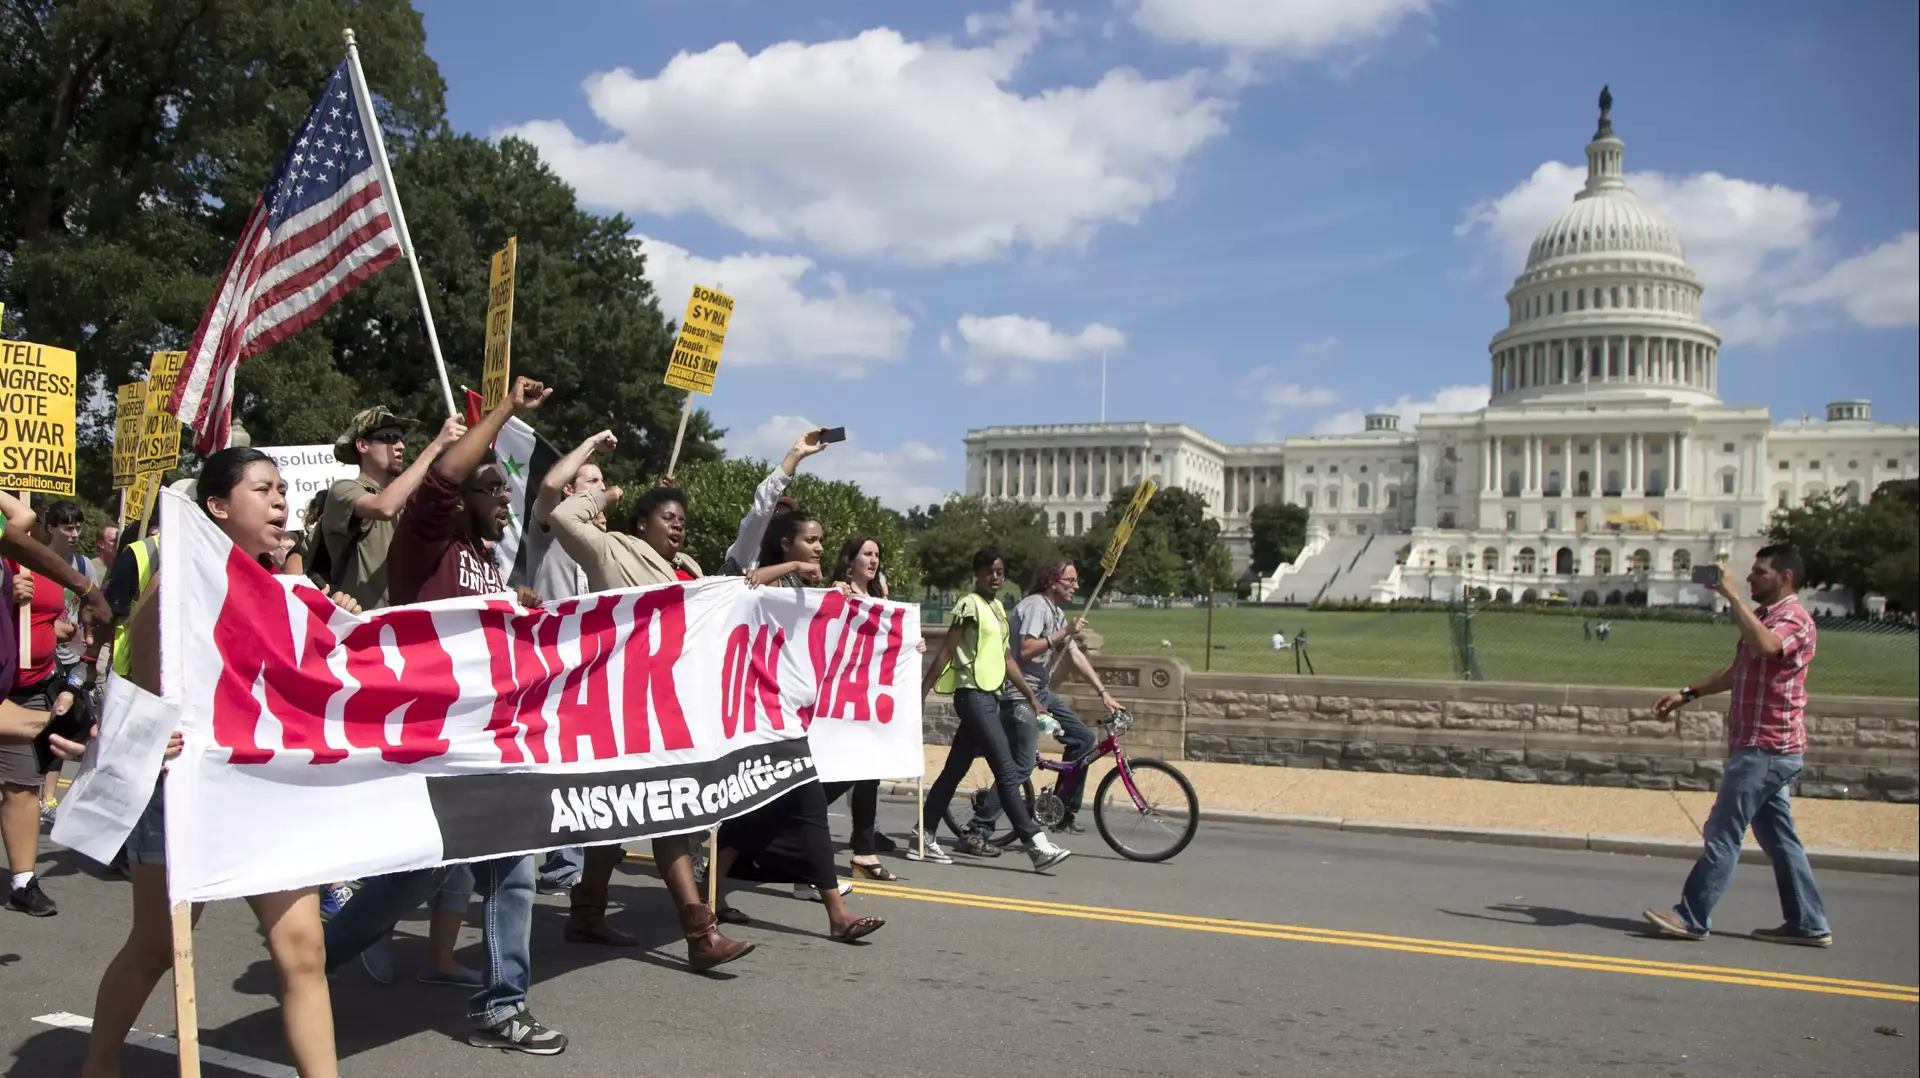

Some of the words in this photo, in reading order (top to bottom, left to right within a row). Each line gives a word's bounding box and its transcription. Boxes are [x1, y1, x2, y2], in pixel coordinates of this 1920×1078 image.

[692, 287, 734, 311] BOMBING
[692, 304, 726, 328] SYRIA
[2, 343, 46, 368] TELL
[673, 349, 701, 370] KILLS
[0, 367, 74, 397] NGRESS:
[128, 383, 140, 400] ELL
[148, 374, 176, 393] CONGR
[0, 393, 47, 416] VOTE
[156, 394, 170, 412] VO
[0, 417, 8, 441] O
[15, 418, 64, 447] WAR
[123, 418, 137, 434] OTE
[3, 446, 72, 475] SYRIA!
[0, 474, 71, 493] erCoalition.org
[295, 478, 320, 492] for
[214, 543, 460, 764] NO
[484, 584, 695, 764] WAR
[721, 623, 786, 740] ON
[796, 590, 906, 733] SIA!
